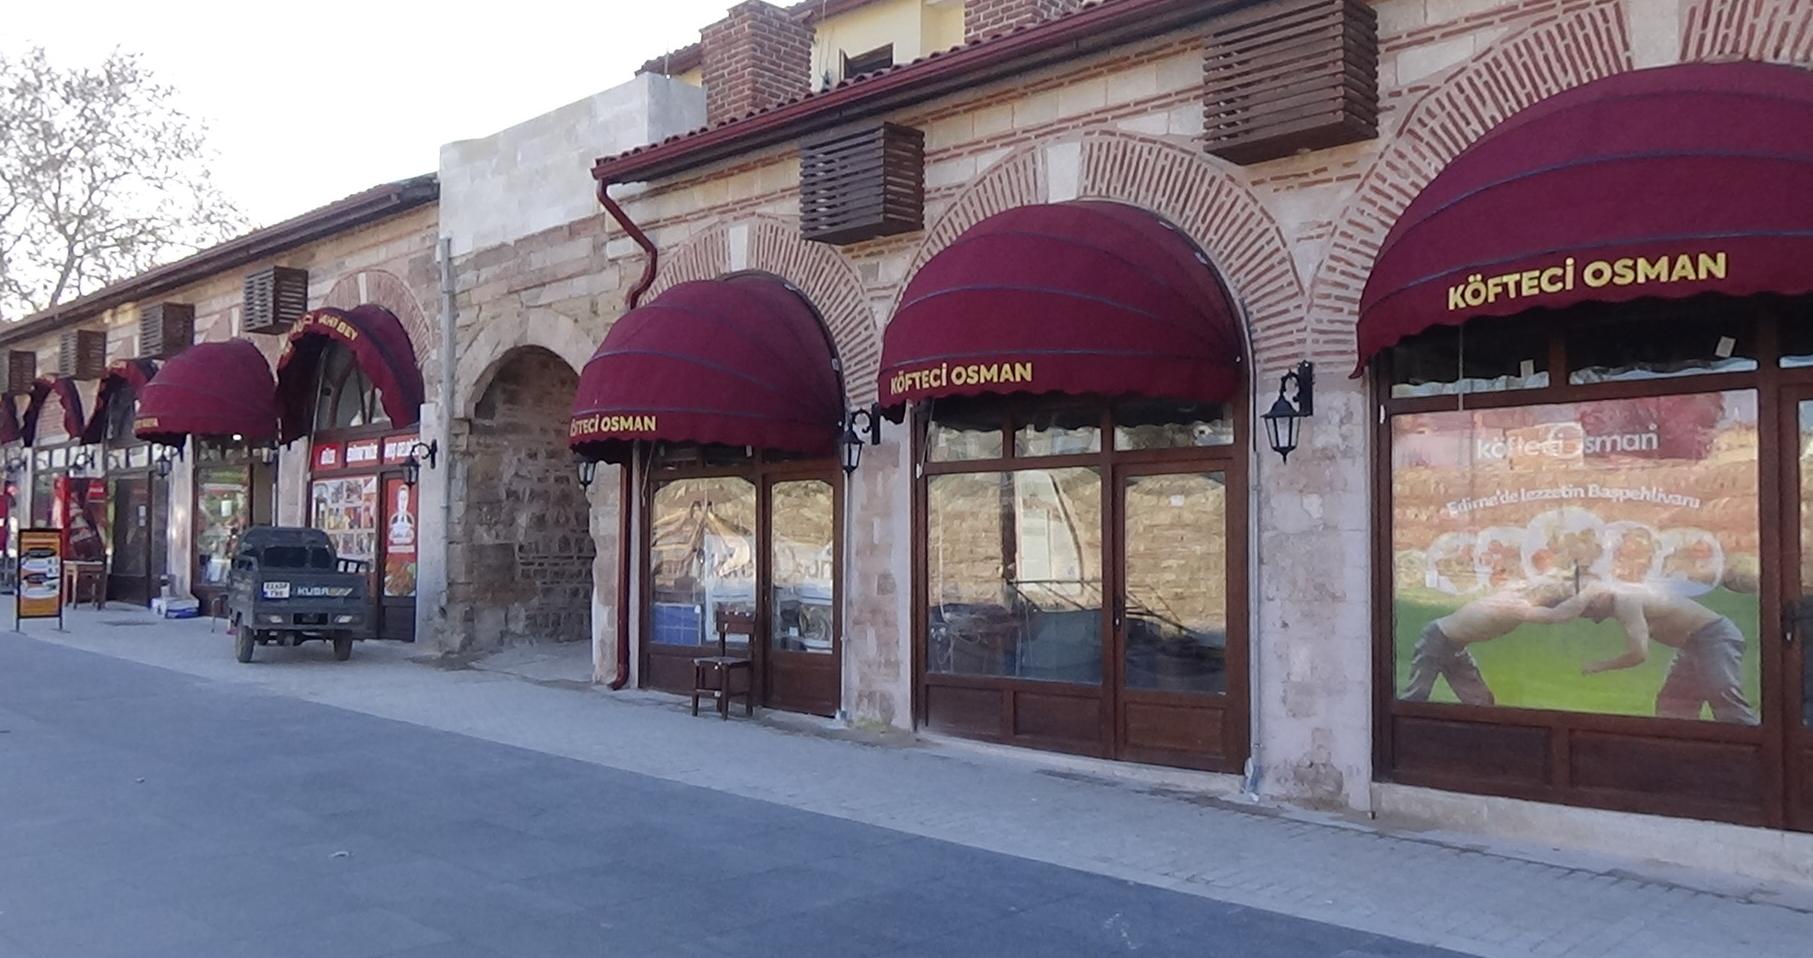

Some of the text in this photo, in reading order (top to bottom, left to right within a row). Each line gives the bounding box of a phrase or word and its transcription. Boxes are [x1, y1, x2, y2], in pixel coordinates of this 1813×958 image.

[1447, 252, 1728, 311] KÖFTECİ OSMAN
[890, 362, 1033, 396] KÖFTECİ OSMAN
[600, 415, 657, 432] OSMAN
